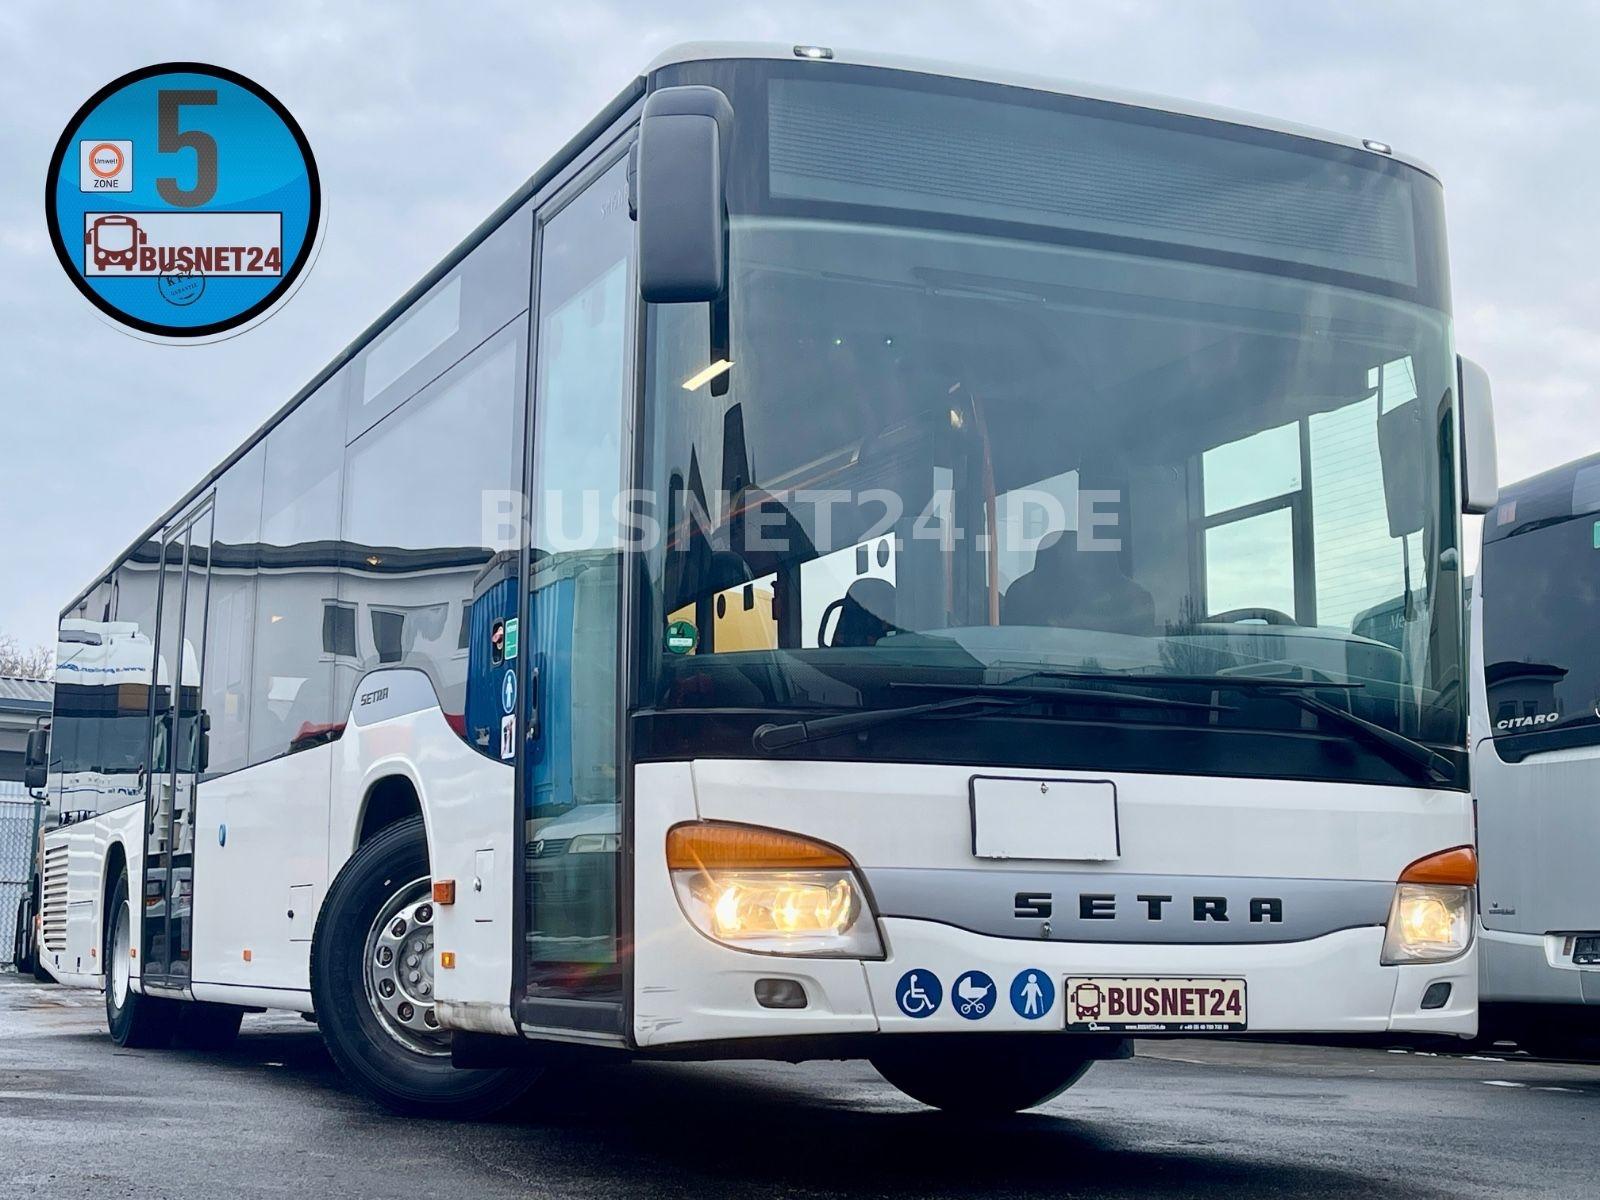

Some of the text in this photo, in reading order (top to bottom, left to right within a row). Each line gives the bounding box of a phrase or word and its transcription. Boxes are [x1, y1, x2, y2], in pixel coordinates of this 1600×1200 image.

[360, 687, 389, 706] SETRA
[1497, 712, 1559, 729] CITARO
[1014, 892, 1283, 923] SETRA
[1108, 987, 1242, 1016] BUSNET24
